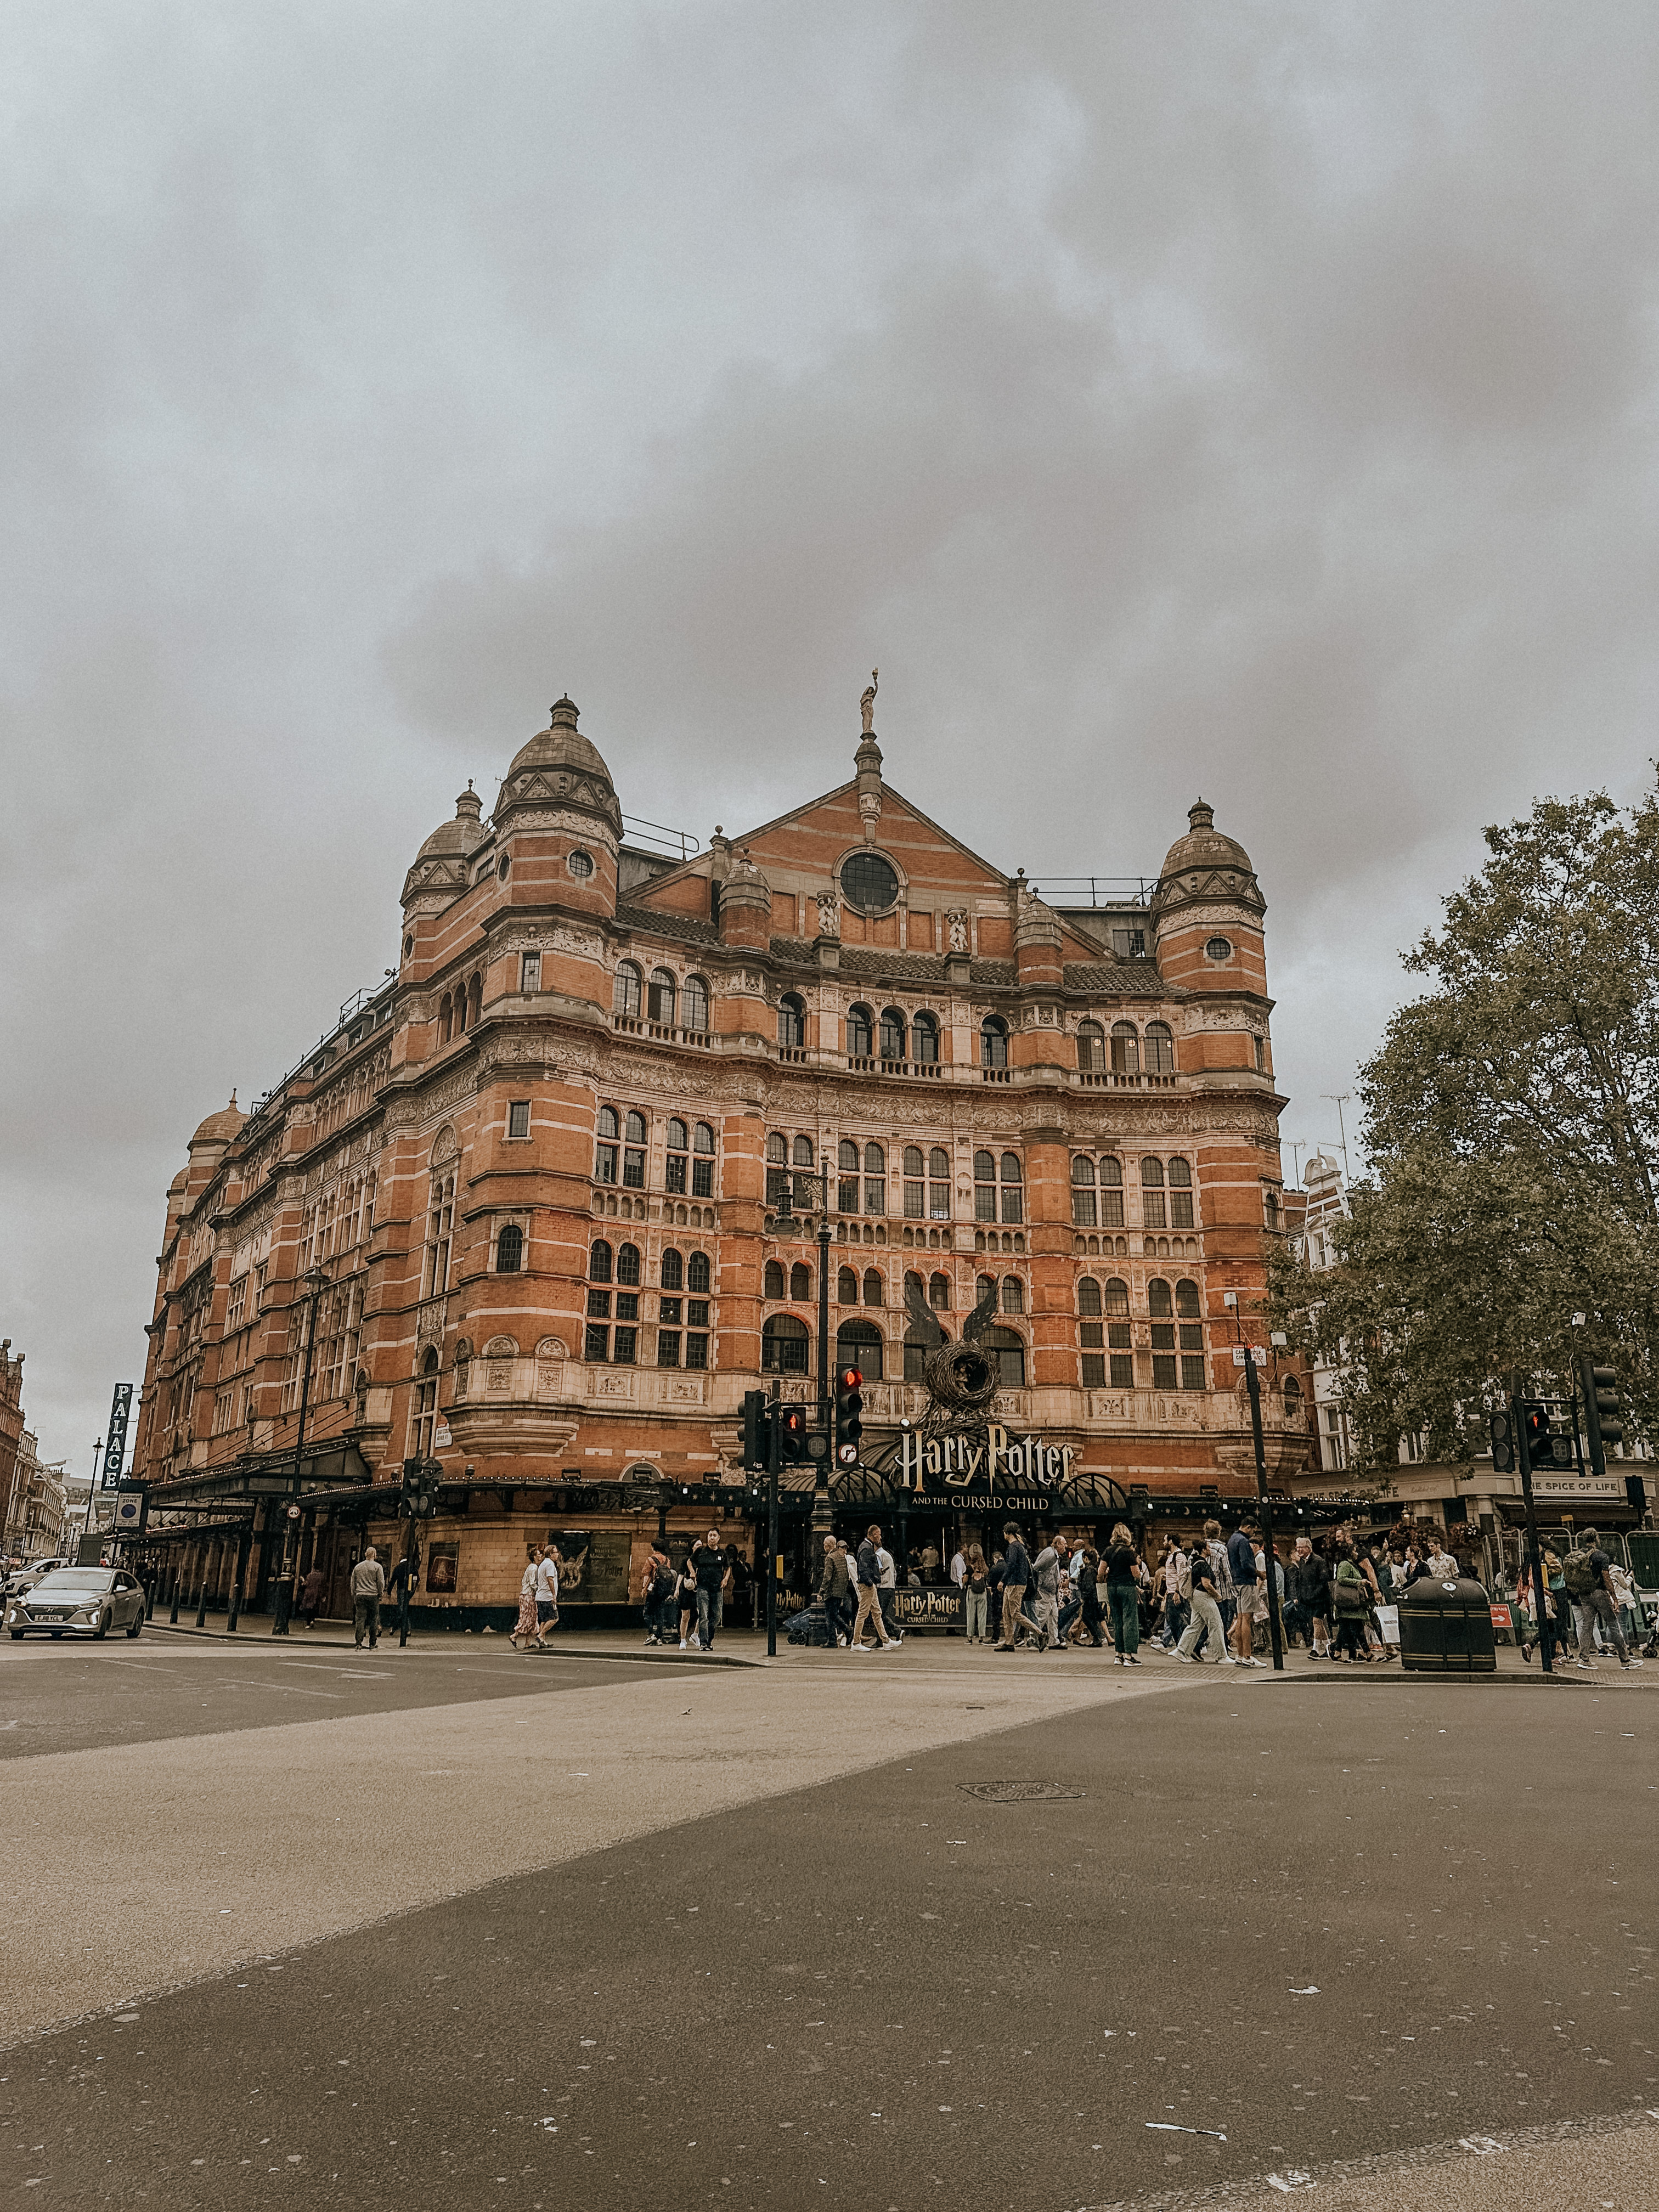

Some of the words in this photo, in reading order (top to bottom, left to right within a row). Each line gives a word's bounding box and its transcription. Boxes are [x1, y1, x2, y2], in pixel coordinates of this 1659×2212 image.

[104, 1385, 129, 1487] PALACE
[895, 1430, 984, 1493] Harry
[986, 1424, 1074, 1496] Potter
[934, 1497, 948, 1505] THE
[951, 1496, 1003, 1510] CURSED
[1007, 1497, 1049, 1510] CHILD
[786, 1589, 805, 1610] Potter
[893, 1594, 927, 1618] Harry
[927, 1592, 961, 1618] Potter
